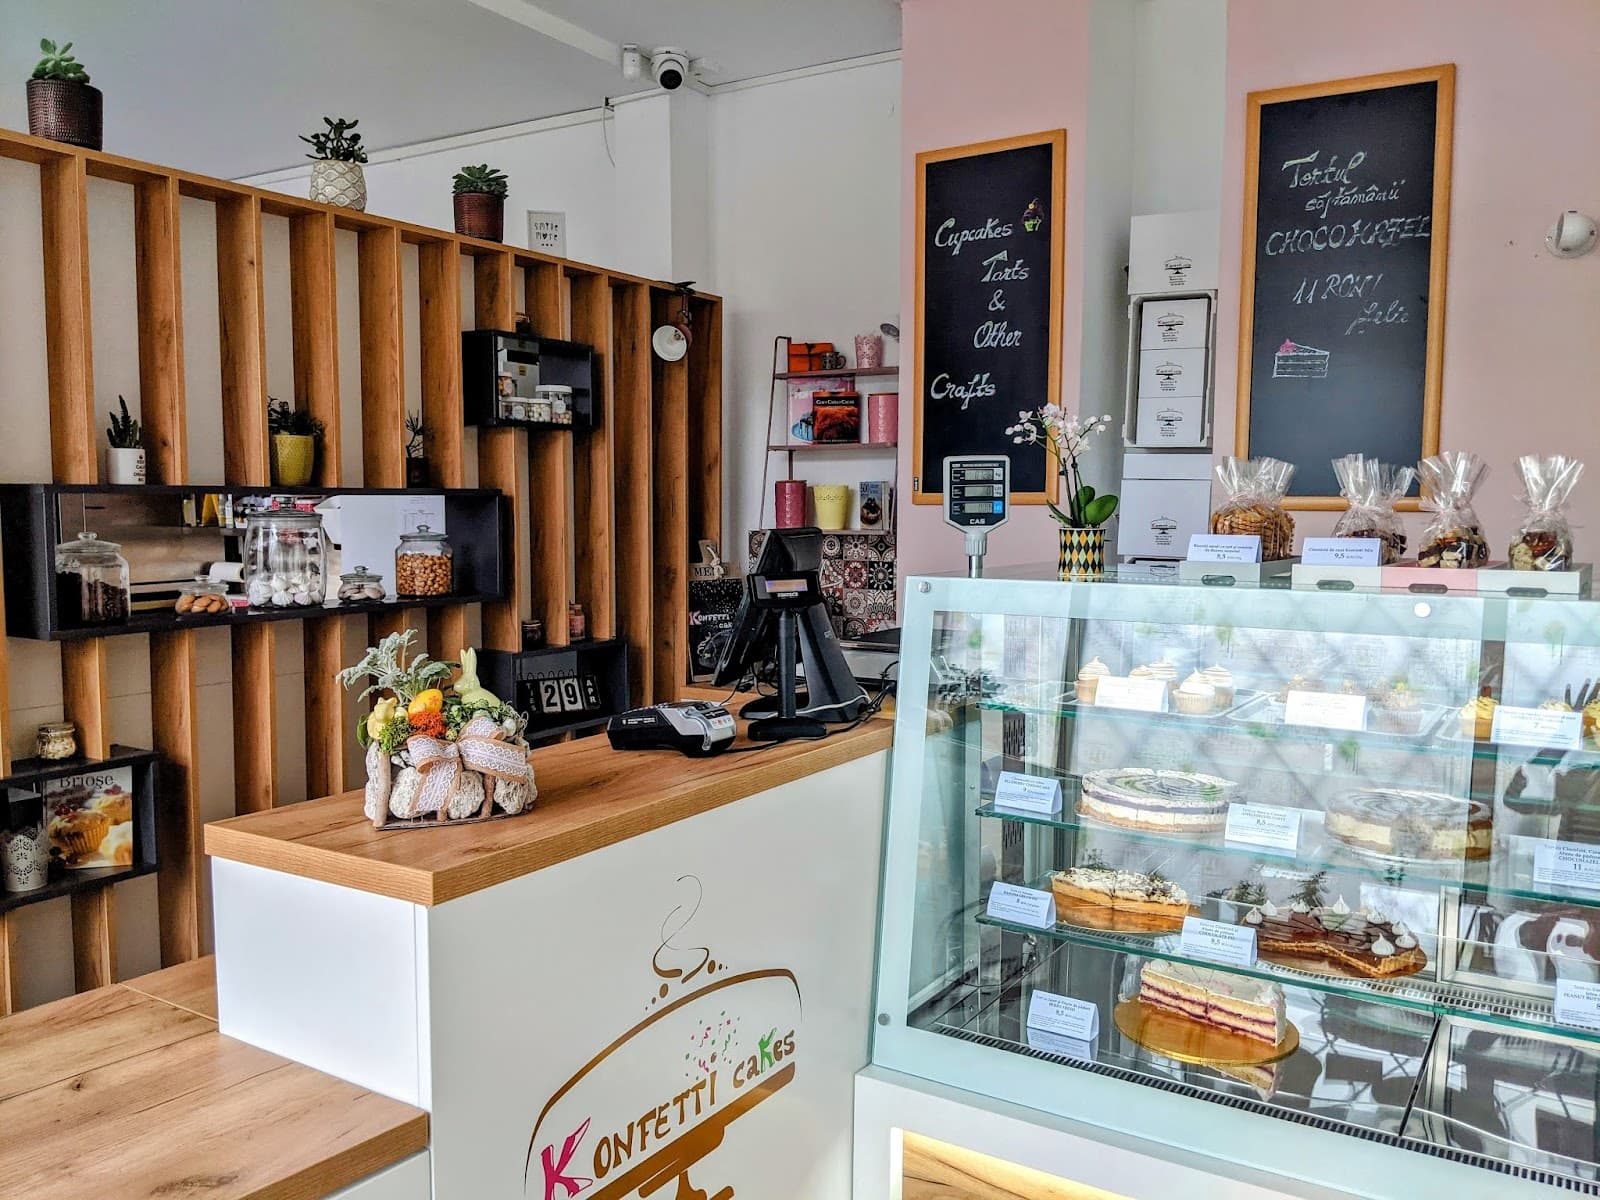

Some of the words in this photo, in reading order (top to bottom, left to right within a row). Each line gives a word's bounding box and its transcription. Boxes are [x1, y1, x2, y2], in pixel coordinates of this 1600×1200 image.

[1282, 150, 1367, 189] Tortul
[981, 250, 1030, 283] Tarts
[988, 289, 1006, 312] &
[1293, 277, 1318, 304] 11
[973, 320, 1023, 349] Other
[930, 372, 997, 411] Crafts
[544, 682, 579, 708] 29
